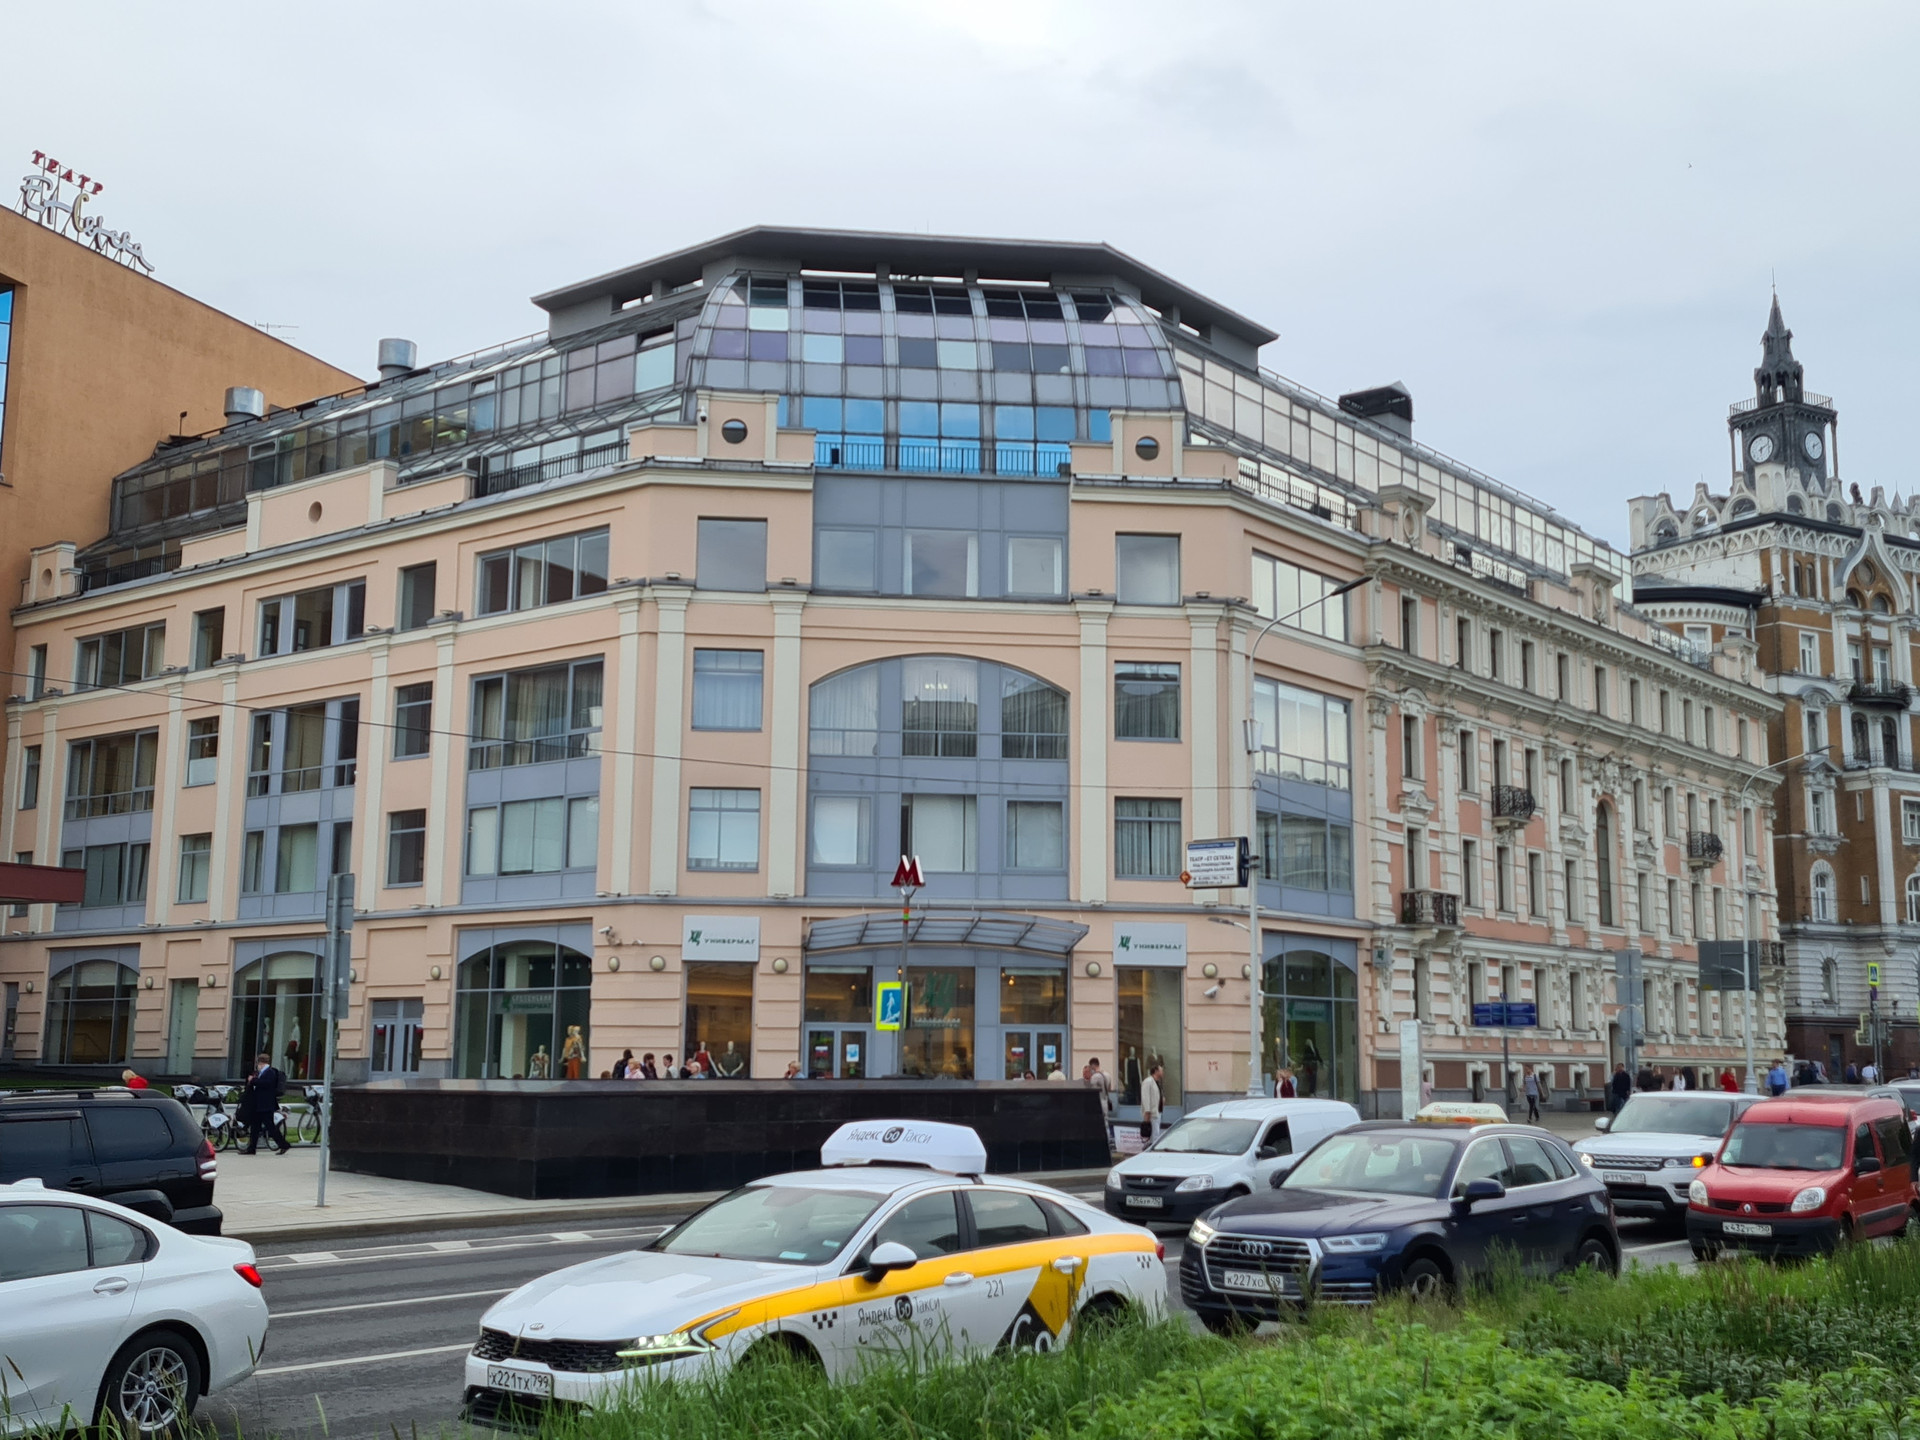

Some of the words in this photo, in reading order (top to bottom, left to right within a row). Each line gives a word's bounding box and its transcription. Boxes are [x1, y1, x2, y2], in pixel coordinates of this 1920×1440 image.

[31, 149, 104, 196] ТЕАТР
[891, 855, 926, 887] М
[847, 1128, 883, 1141] Яндекс
[902, 1130, 933, 1144] Такси
[985, 1278, 1005, 1299] 221
[858, 1307, 893, 1328] Яндекс
[913, 1297, 941, 1315] Такси
[532, 1373, 549, 1389] 799
